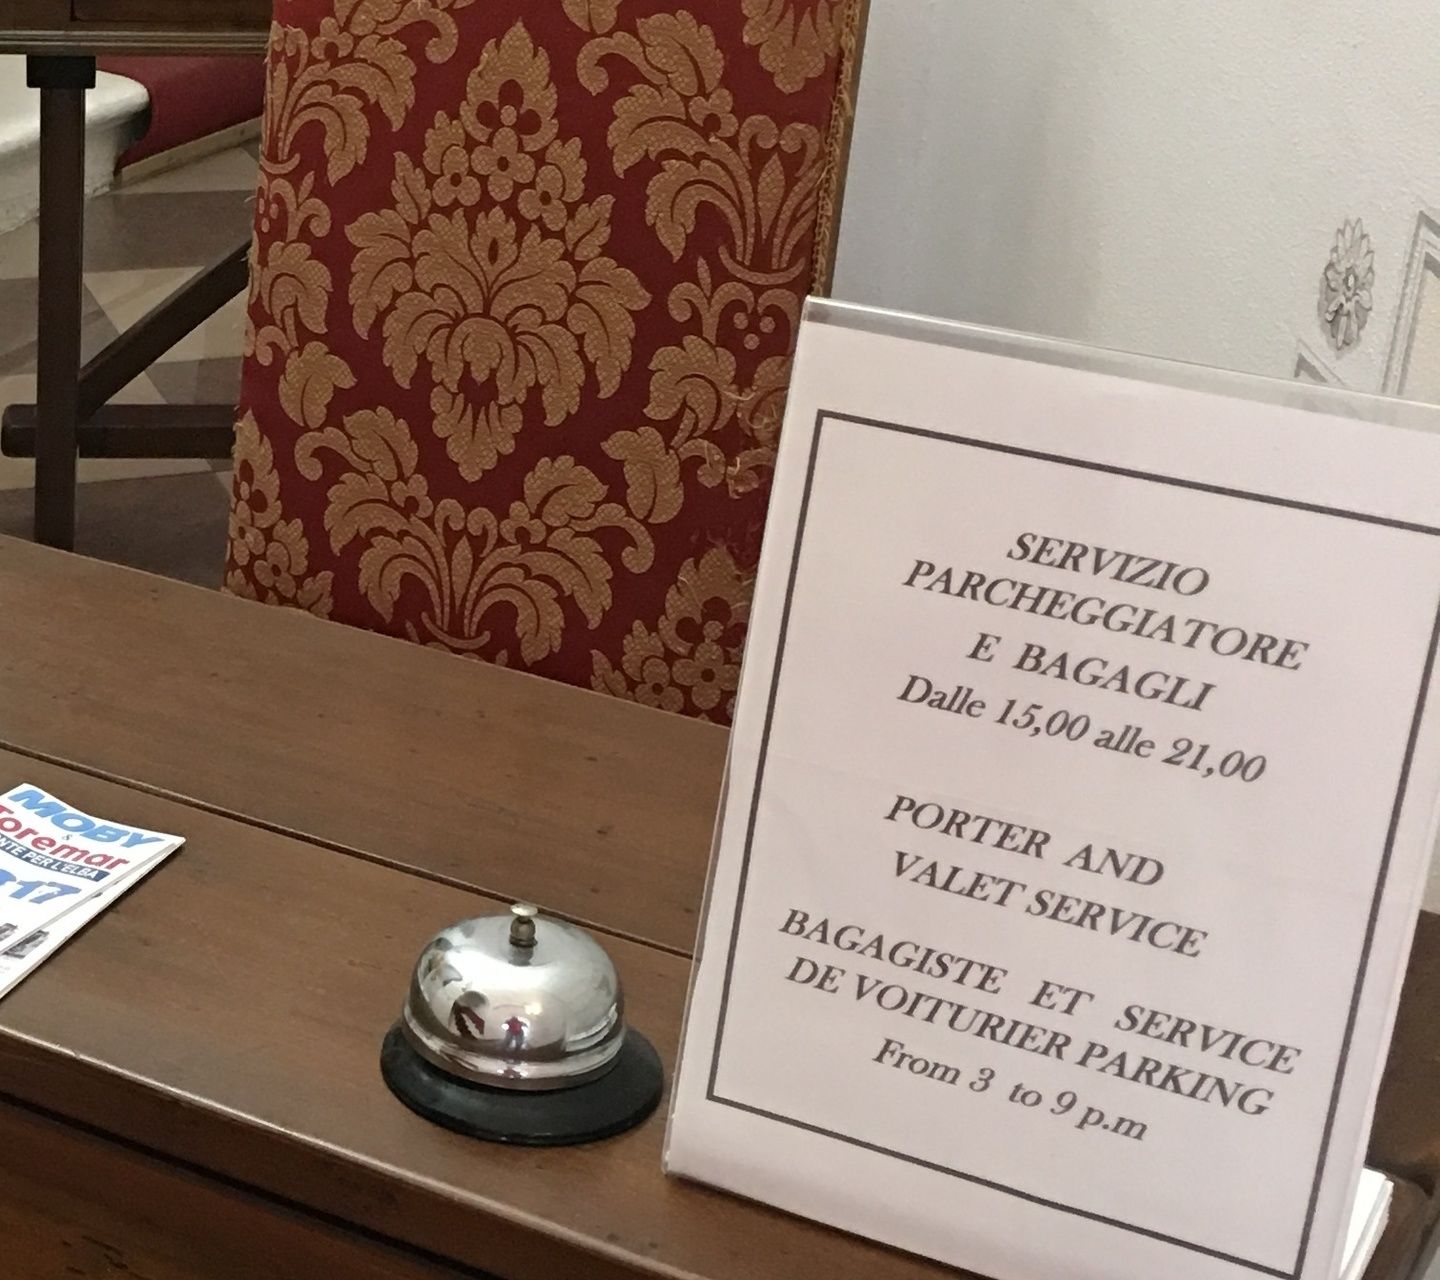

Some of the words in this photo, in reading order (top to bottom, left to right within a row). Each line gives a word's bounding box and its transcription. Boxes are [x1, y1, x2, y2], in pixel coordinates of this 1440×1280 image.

[901, 558, 1311, 672] PARCHEGGIATORE
[1005, 531, 1211, 597] SERVIZIO
[965, 631, 1003, 664] E
[1011, 641, 1218, 712] BAGAGLI
[895, 673, 987, 719] Dalle
[994, 698, 1092, 743] 15,00
[1092, 723, 1157, 759] alle
[1160, 736, 1268, 784] 21,00
[7, 789, 165, 848] MOBY
[22, 850, 53, 867] PER
[51, 858, 100, 879] L'ELBA
[882, 793, 1052, 860] PORTER
[1061, 843, 1165, 887] AND
[894, 849, 1028, 908] VALET
[1024, 888, 1210, 959] SERVICE
[777, 907, 1009, 995] BAGAGISTE
[1028, 979, 1097, 1017] ET
[1113, 1003, 1303, 1076] SERVICE
[784, 955, 848, 995] DE
[855, 973, 1073, 1062] VOITURIER
[1074, 1040, 1276, 1116] PARKING
[871, 1037, 962, 1087] From
[967, 1066, 997, 1094] 3
[1007, 1081, 1044, 1108] to
[1049, 1090, 1079, 1116] 9
[1073, 1105, 1149, 1142] p.m
